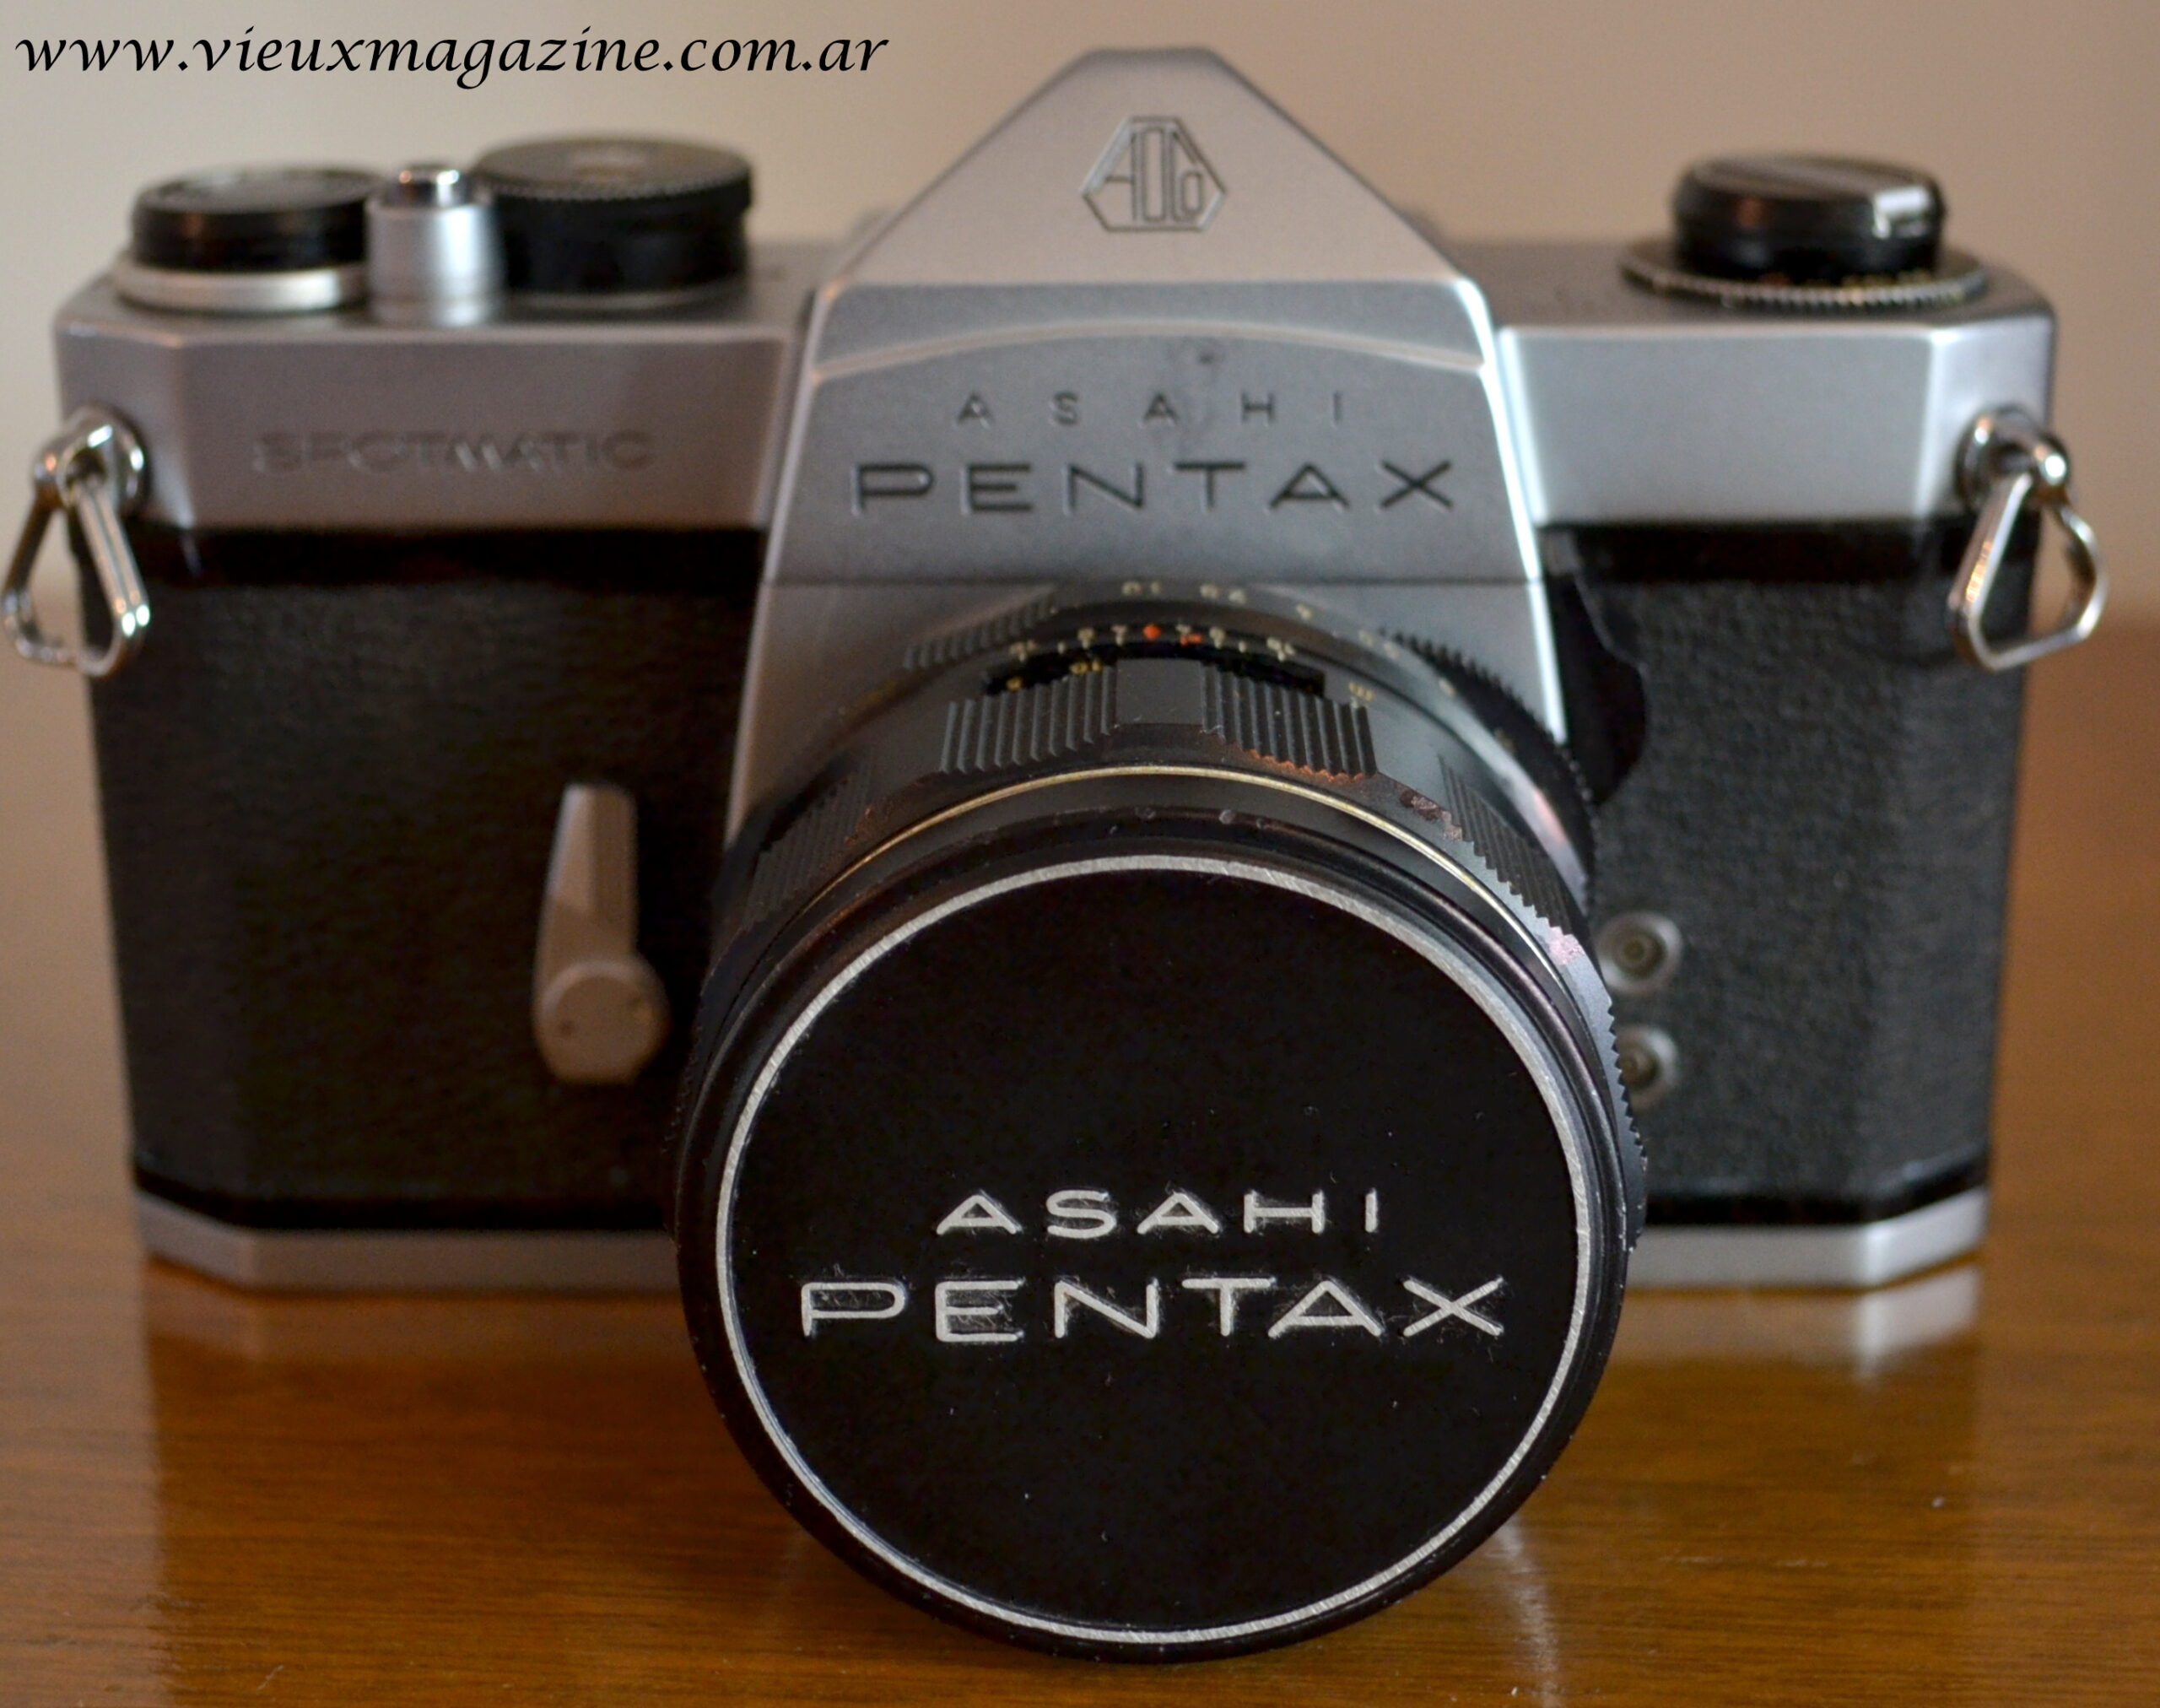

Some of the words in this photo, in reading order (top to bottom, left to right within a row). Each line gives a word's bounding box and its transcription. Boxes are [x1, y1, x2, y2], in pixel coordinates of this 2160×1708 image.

[957, 392, 1344, 428] ASAHI
[850, 460, 1454, 516] PENTAX
[937, 1189, 1380, 1240] ASAHI
[801, 1276, 1505, 1342] PENTAX
